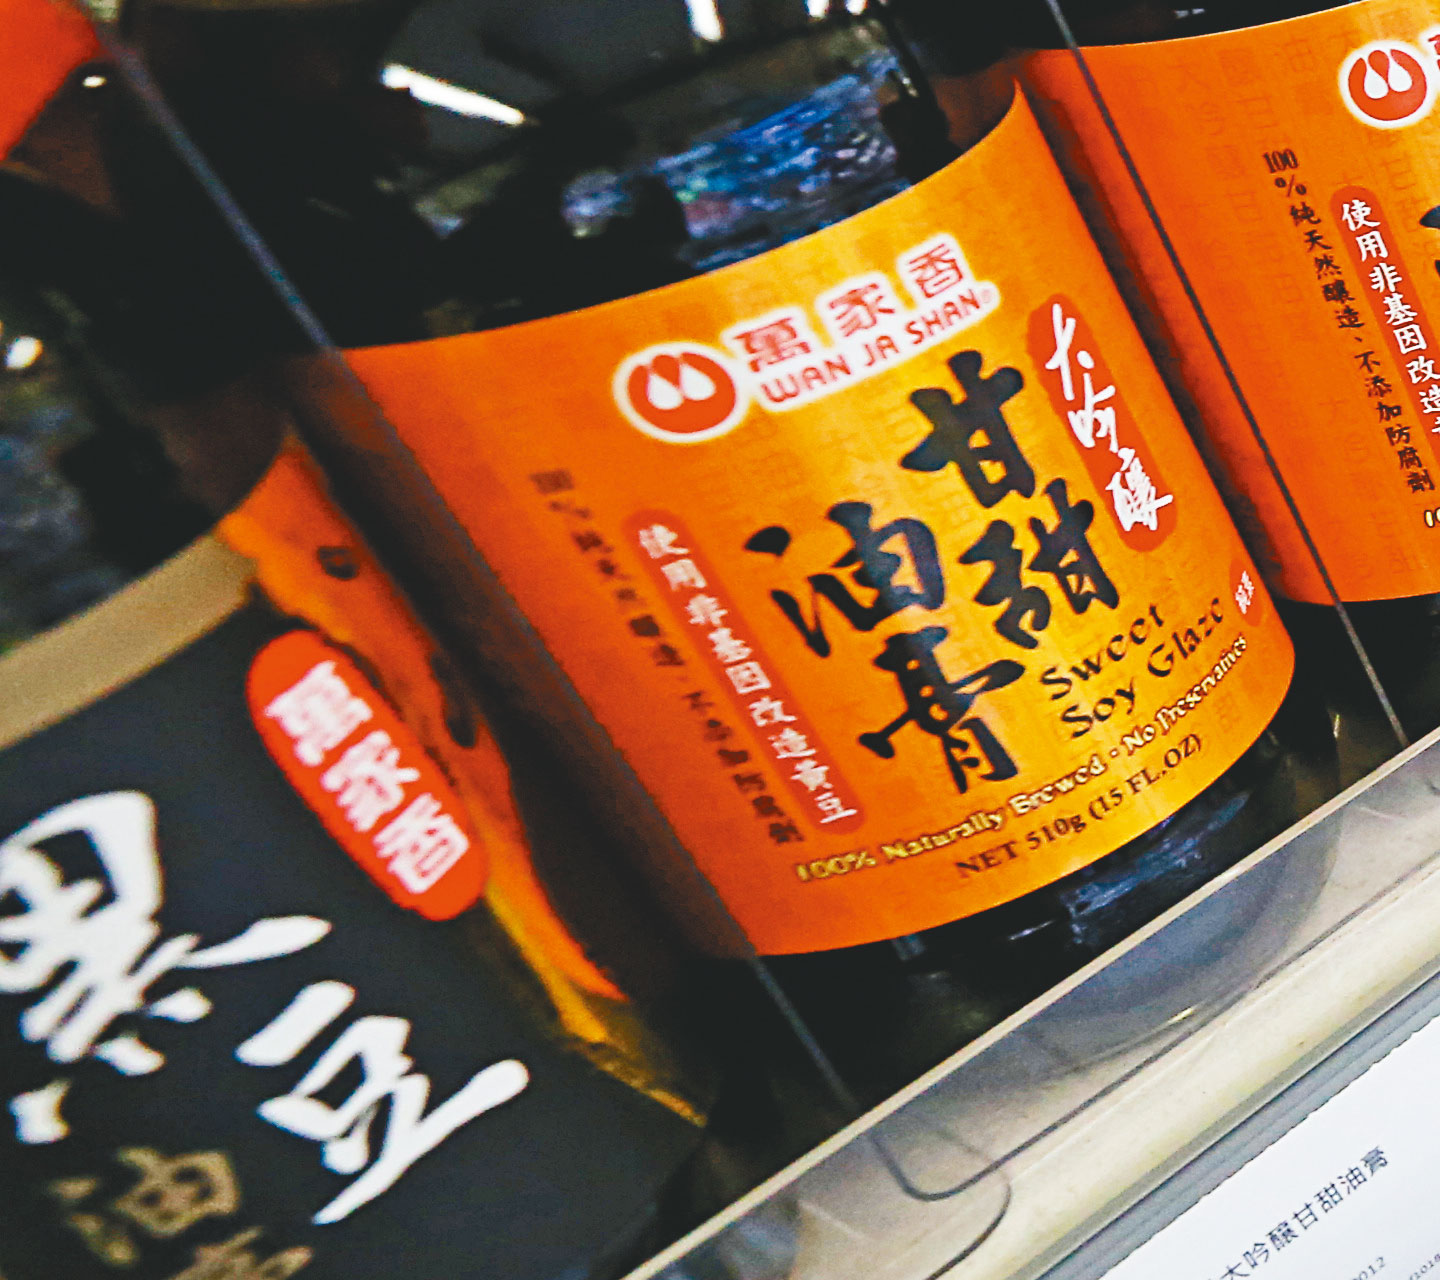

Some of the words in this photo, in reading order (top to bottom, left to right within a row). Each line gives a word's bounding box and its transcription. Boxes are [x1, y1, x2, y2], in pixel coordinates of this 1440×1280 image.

[735, 240, 969, 373] 萬家香
[760, 354, 851, 403] WAN
[863, 330, 898, 368] JA
[907, 293, 983, 345] SHAN
[901, 349, 1120, 649] 甘甜
[744, 500, 1025, 795] 油膏
[1041, 602, 1166, 702] Sweet
[1061, 677, 1137, 740] Soy
[1145, 597, 1226, 681] Glaze
[796, 844, 877, 884] 100%
[881, 803, 1003, 864] Naturally
[1008, 752, 1107, 816] Brewed
[1121, 723, 1156, 753] No
[1153, 634, 1249, 738] Preservatives
[955, 836, 1019, 878] NET
[1025, 806, 1085, 852] 510g
[0, 789, 531, 1225] 黑豆
